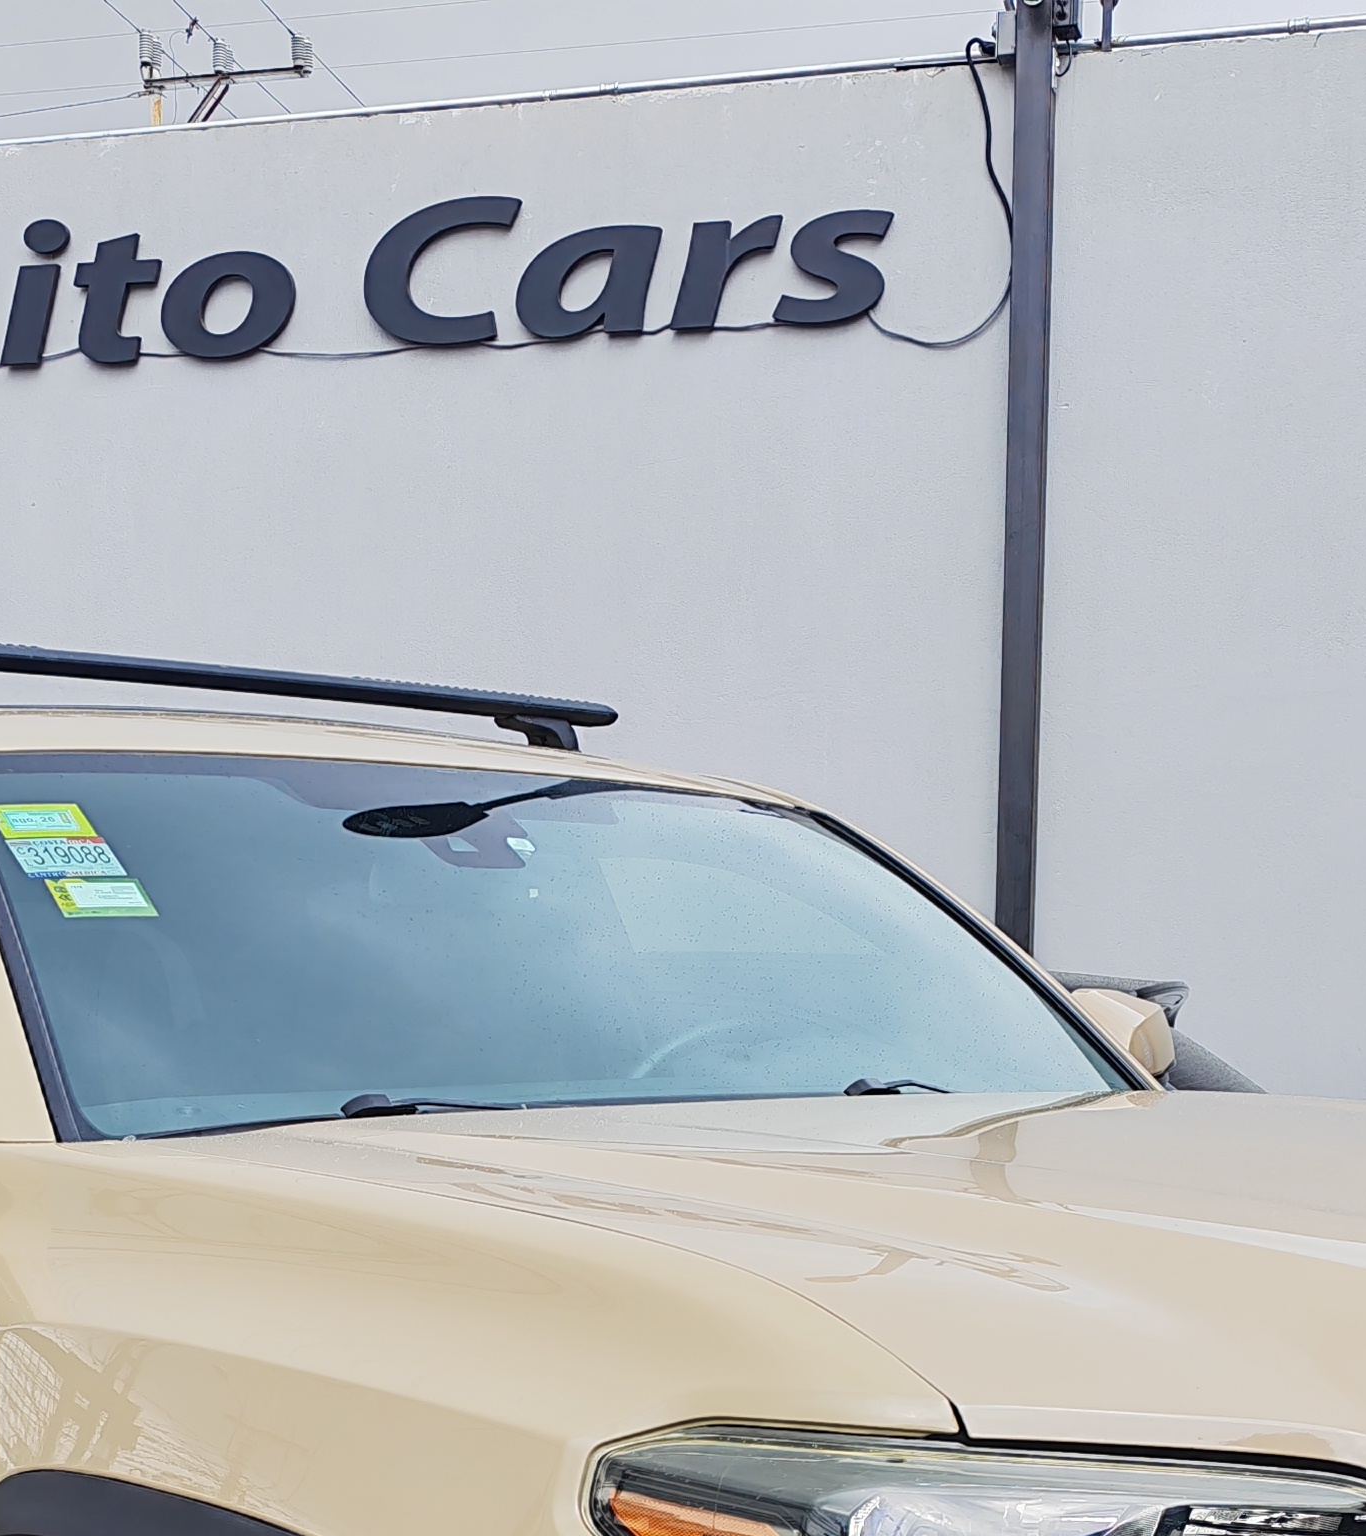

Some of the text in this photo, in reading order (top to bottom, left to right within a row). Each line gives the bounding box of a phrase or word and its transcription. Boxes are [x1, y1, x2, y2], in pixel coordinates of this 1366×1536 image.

[363, 195, 894, 347] Cars
[16, 846, 26, 855] C
[27, 845, 111, 866] 319088
